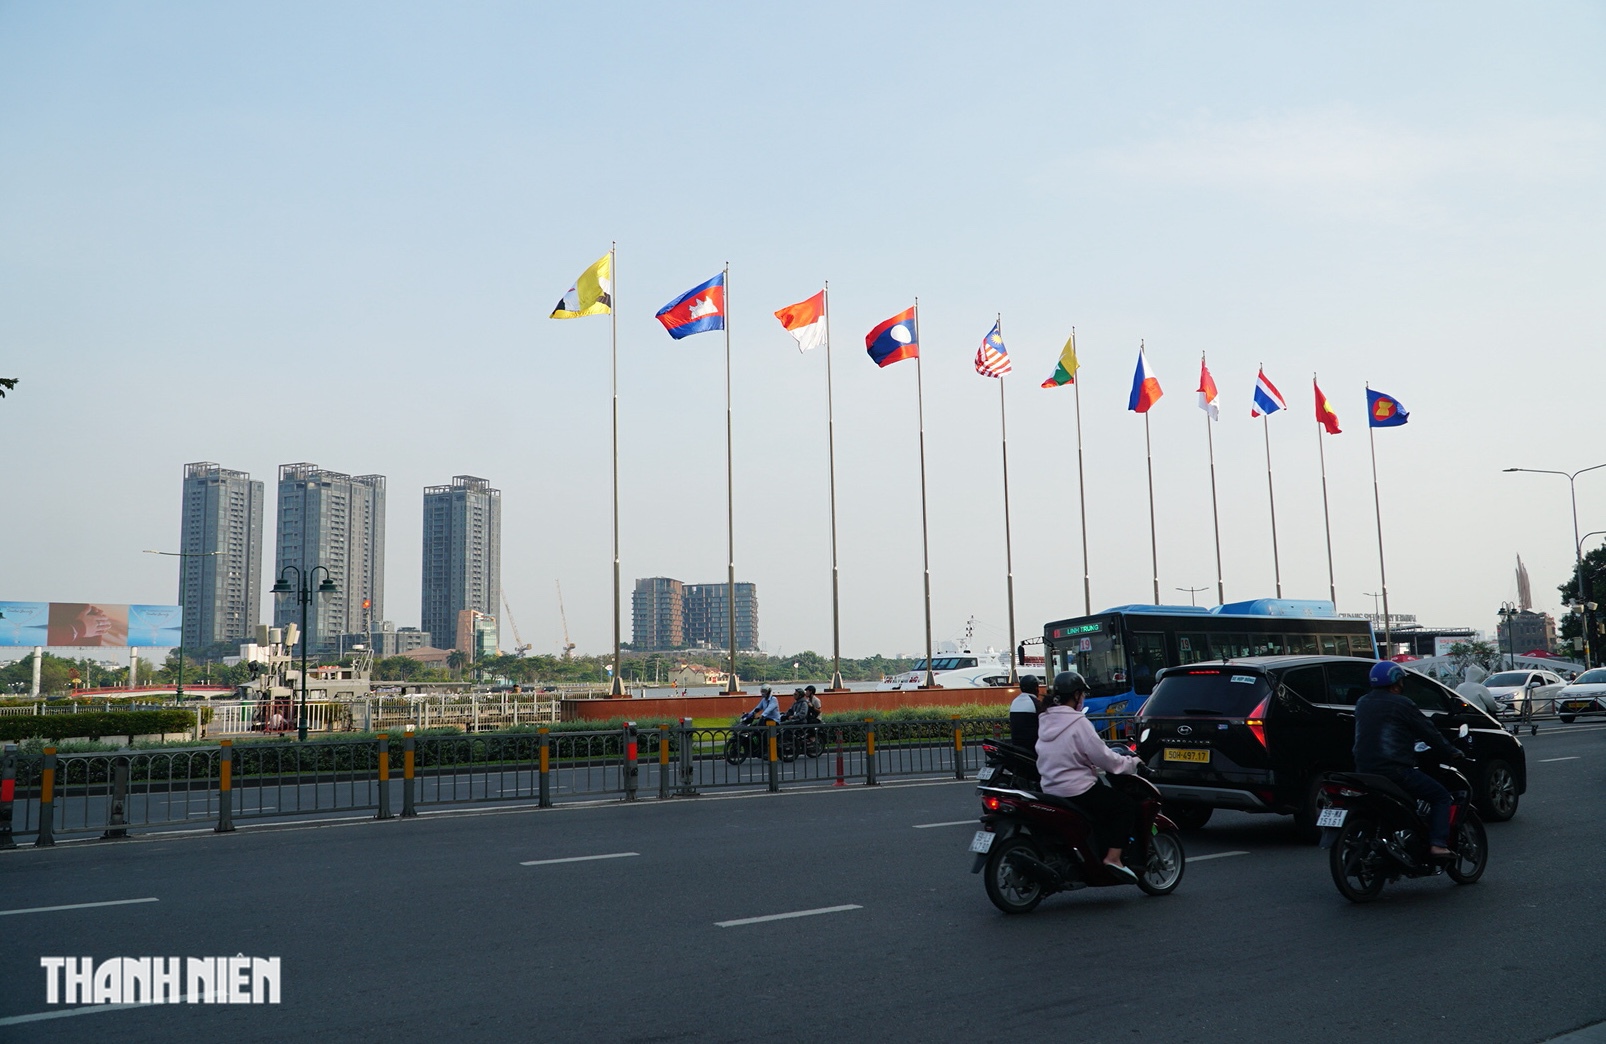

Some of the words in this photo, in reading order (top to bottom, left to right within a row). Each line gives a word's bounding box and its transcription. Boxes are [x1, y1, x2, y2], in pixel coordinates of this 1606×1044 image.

[1067, 627, 1080, 635] LINH
[1080, 624, 1099, 632] TRUNG
[1081, 639, 1090, 650] 19
[1181, 639, 1189, 650] 19
[1168, 750, 1206, 760] 50H-497.17
